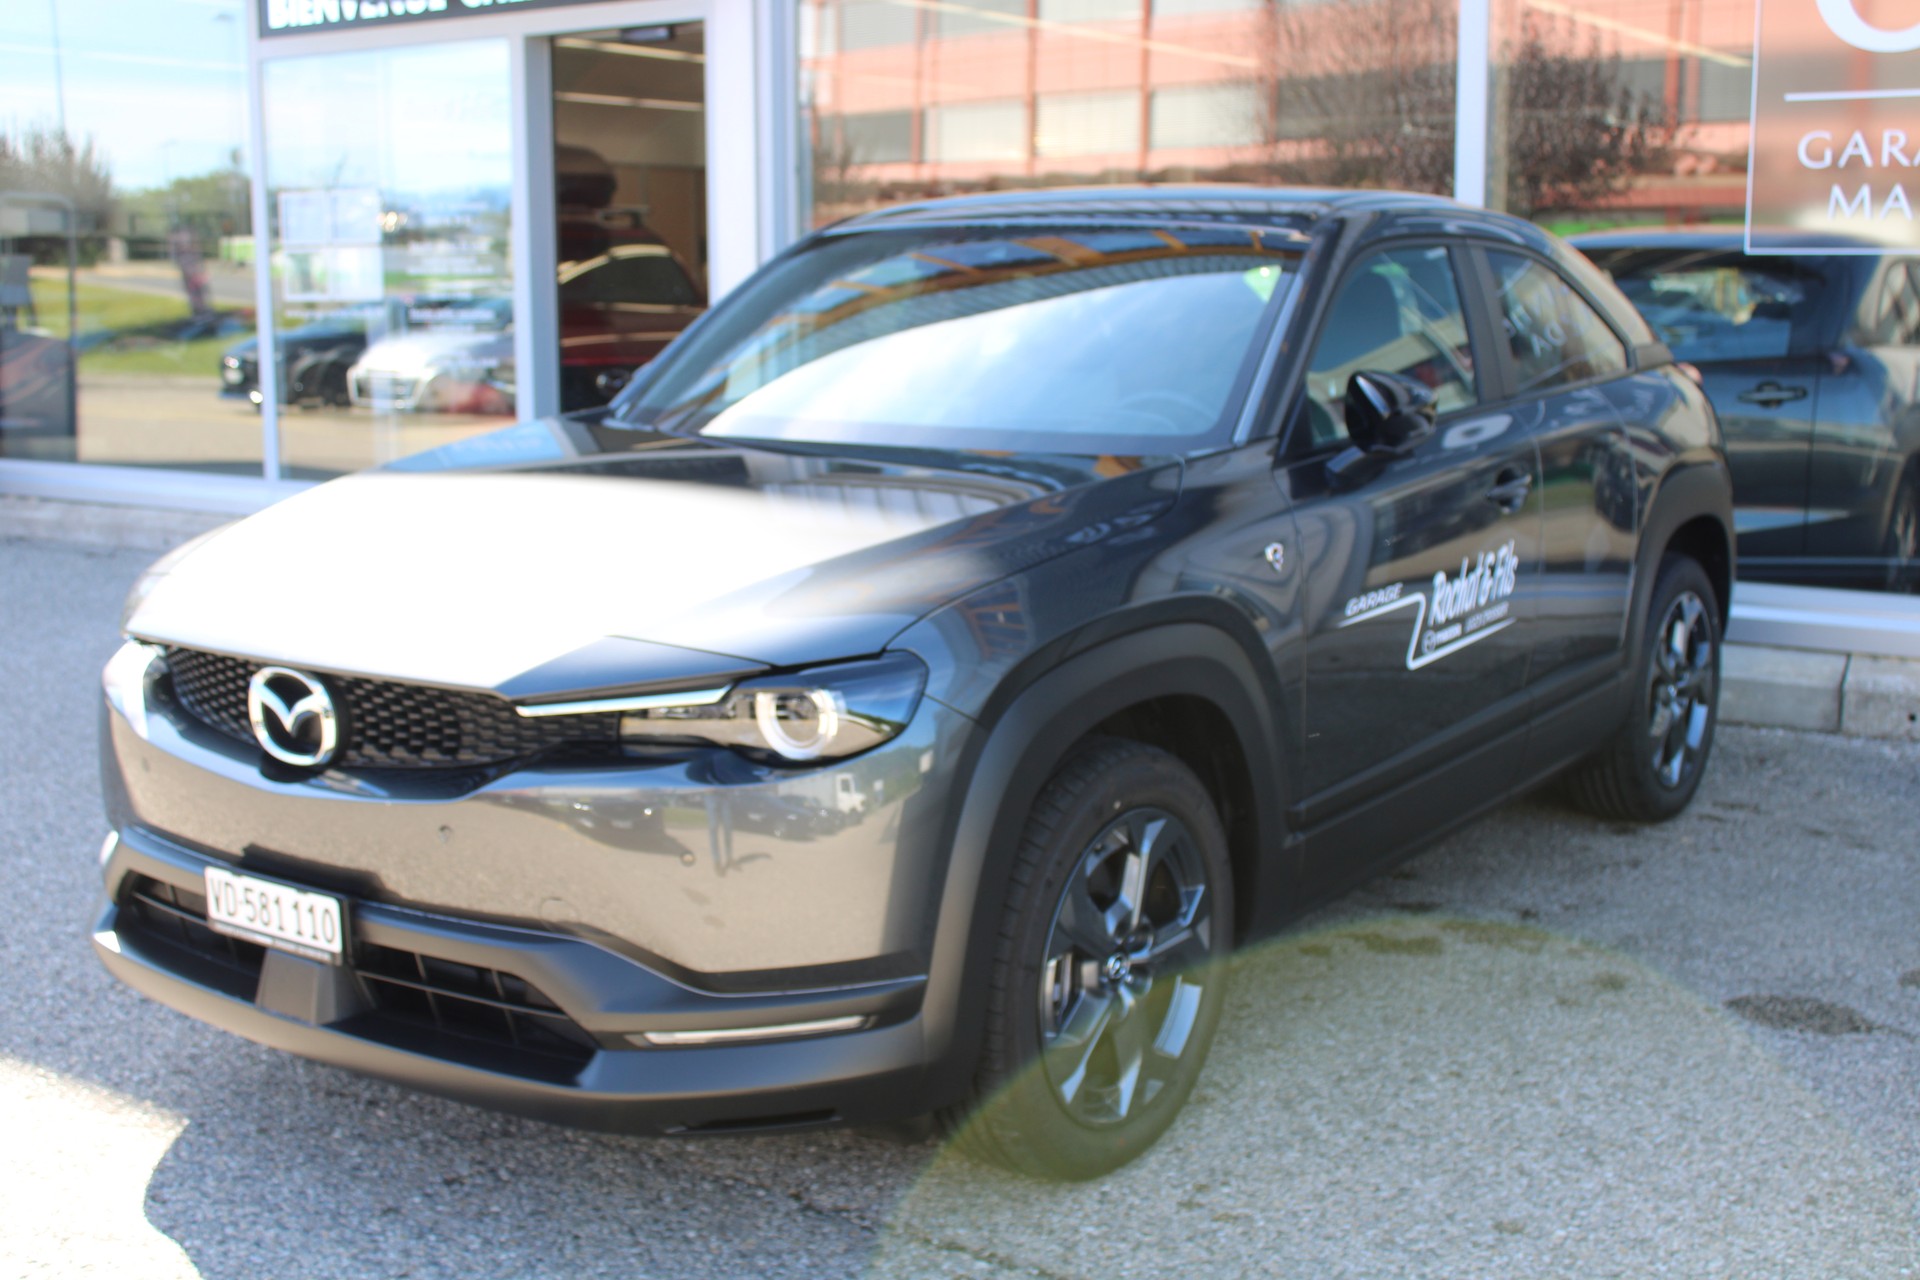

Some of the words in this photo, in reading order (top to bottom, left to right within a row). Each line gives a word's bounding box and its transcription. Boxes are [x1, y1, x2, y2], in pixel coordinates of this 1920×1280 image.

[267, 0, 448, 29] BIENV
[1797, 129, 1920, 169] GAR
[1344, 582, 1404, 616] GARAGE
[292, 900, 336, 944] 110
